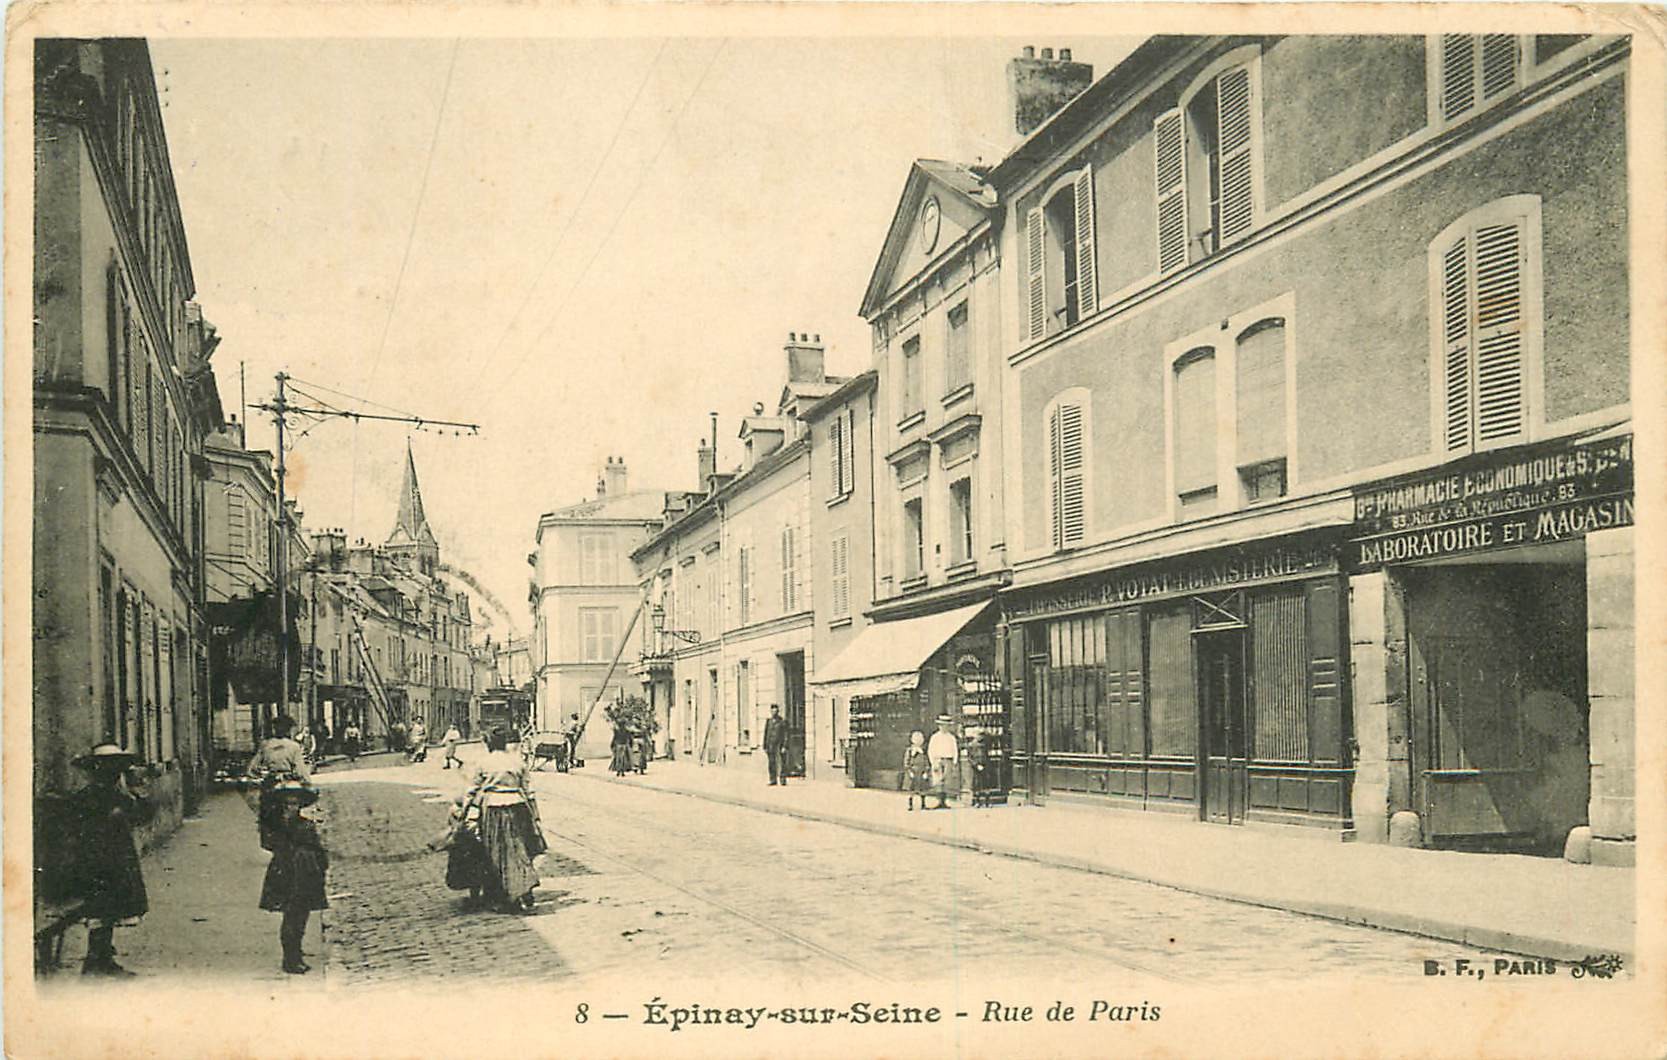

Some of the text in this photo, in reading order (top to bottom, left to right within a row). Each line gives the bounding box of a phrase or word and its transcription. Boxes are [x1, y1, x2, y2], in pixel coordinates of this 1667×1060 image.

[1376, 475, 1461, 518] PHARMACIE
[1412, 510, 1435, 527] Rue
[1360, 522, 1493, 566] LABORATOIRE
[1503, 521, 1527, 543] ET
